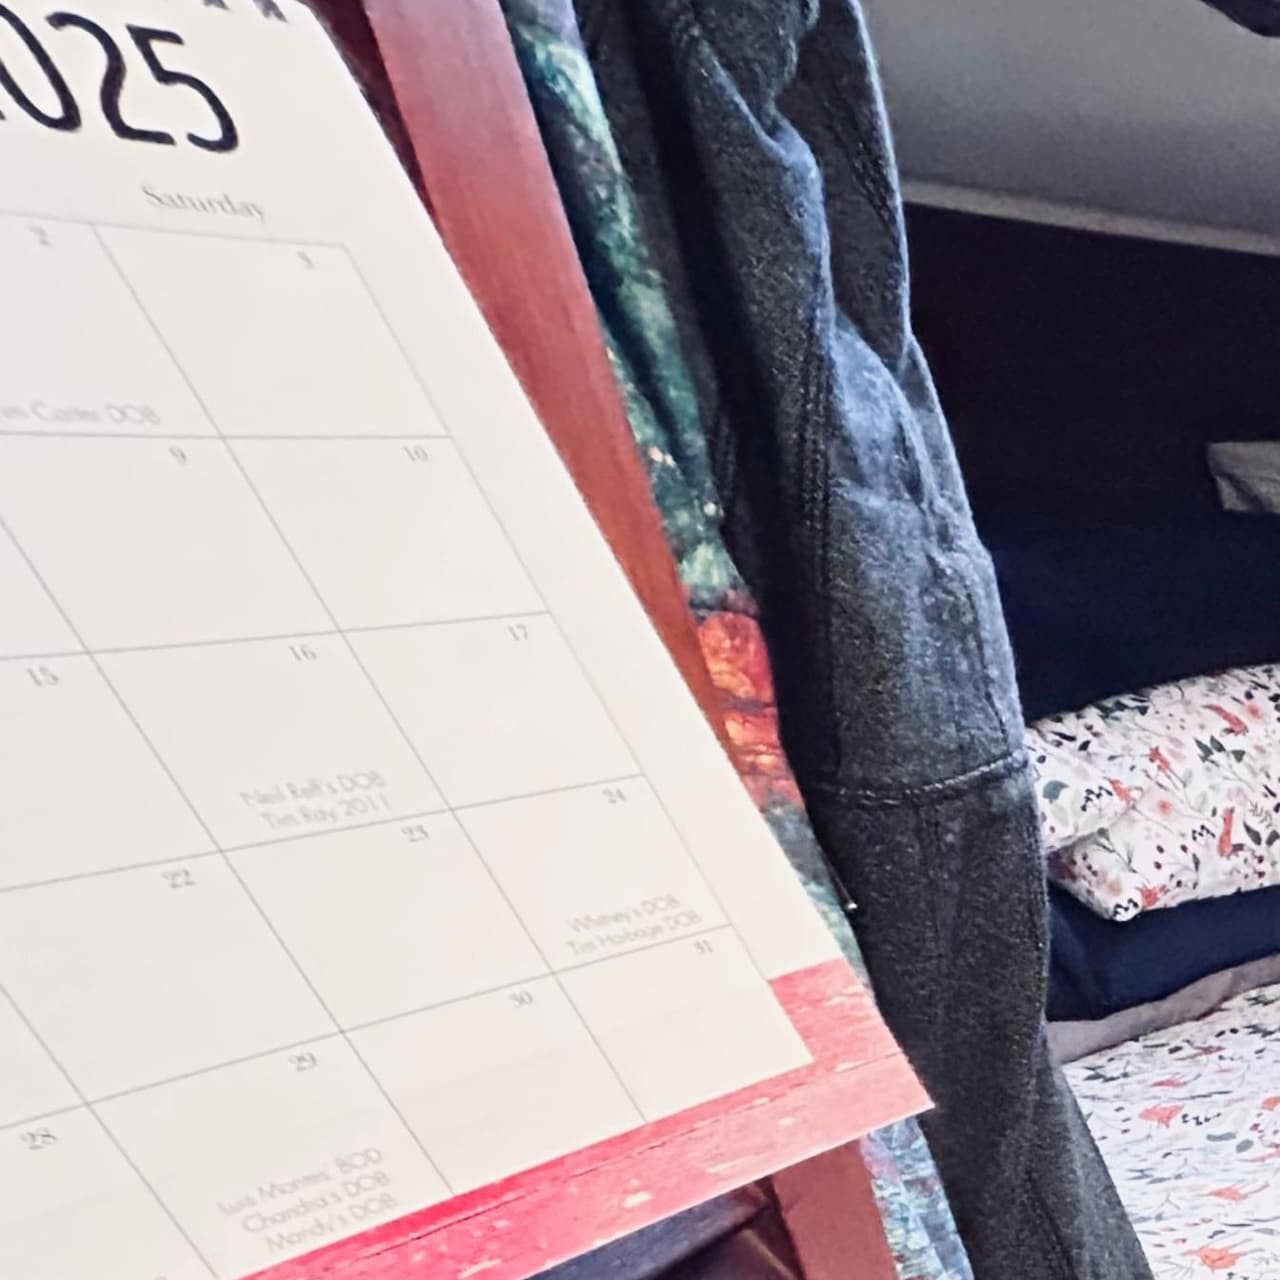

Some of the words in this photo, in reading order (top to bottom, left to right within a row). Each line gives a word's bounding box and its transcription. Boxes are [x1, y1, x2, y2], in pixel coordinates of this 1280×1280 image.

[0, 4, 239, 152] 025
[140, 184, 265, 223] Saturday
[170, 446, 187, 466] 9
[402, 445, 428, 462] 10
[507, 624, 530, 641] 17
[288, 645, 317, 662] 16
[26, 666, 59, 687] 15
[601, 787, 627, 805] 24
[401, 824, 430, 843] 23
[161, 868, 196, 890] 22
[508, 990, 533, 1008] 30
[288, 1052, 318, 1072] 29
[19, 1128, 58, 1151] 28
[343, 1170, 392, 1198] DOB
[349, 1192, 397, 1220] DOB
